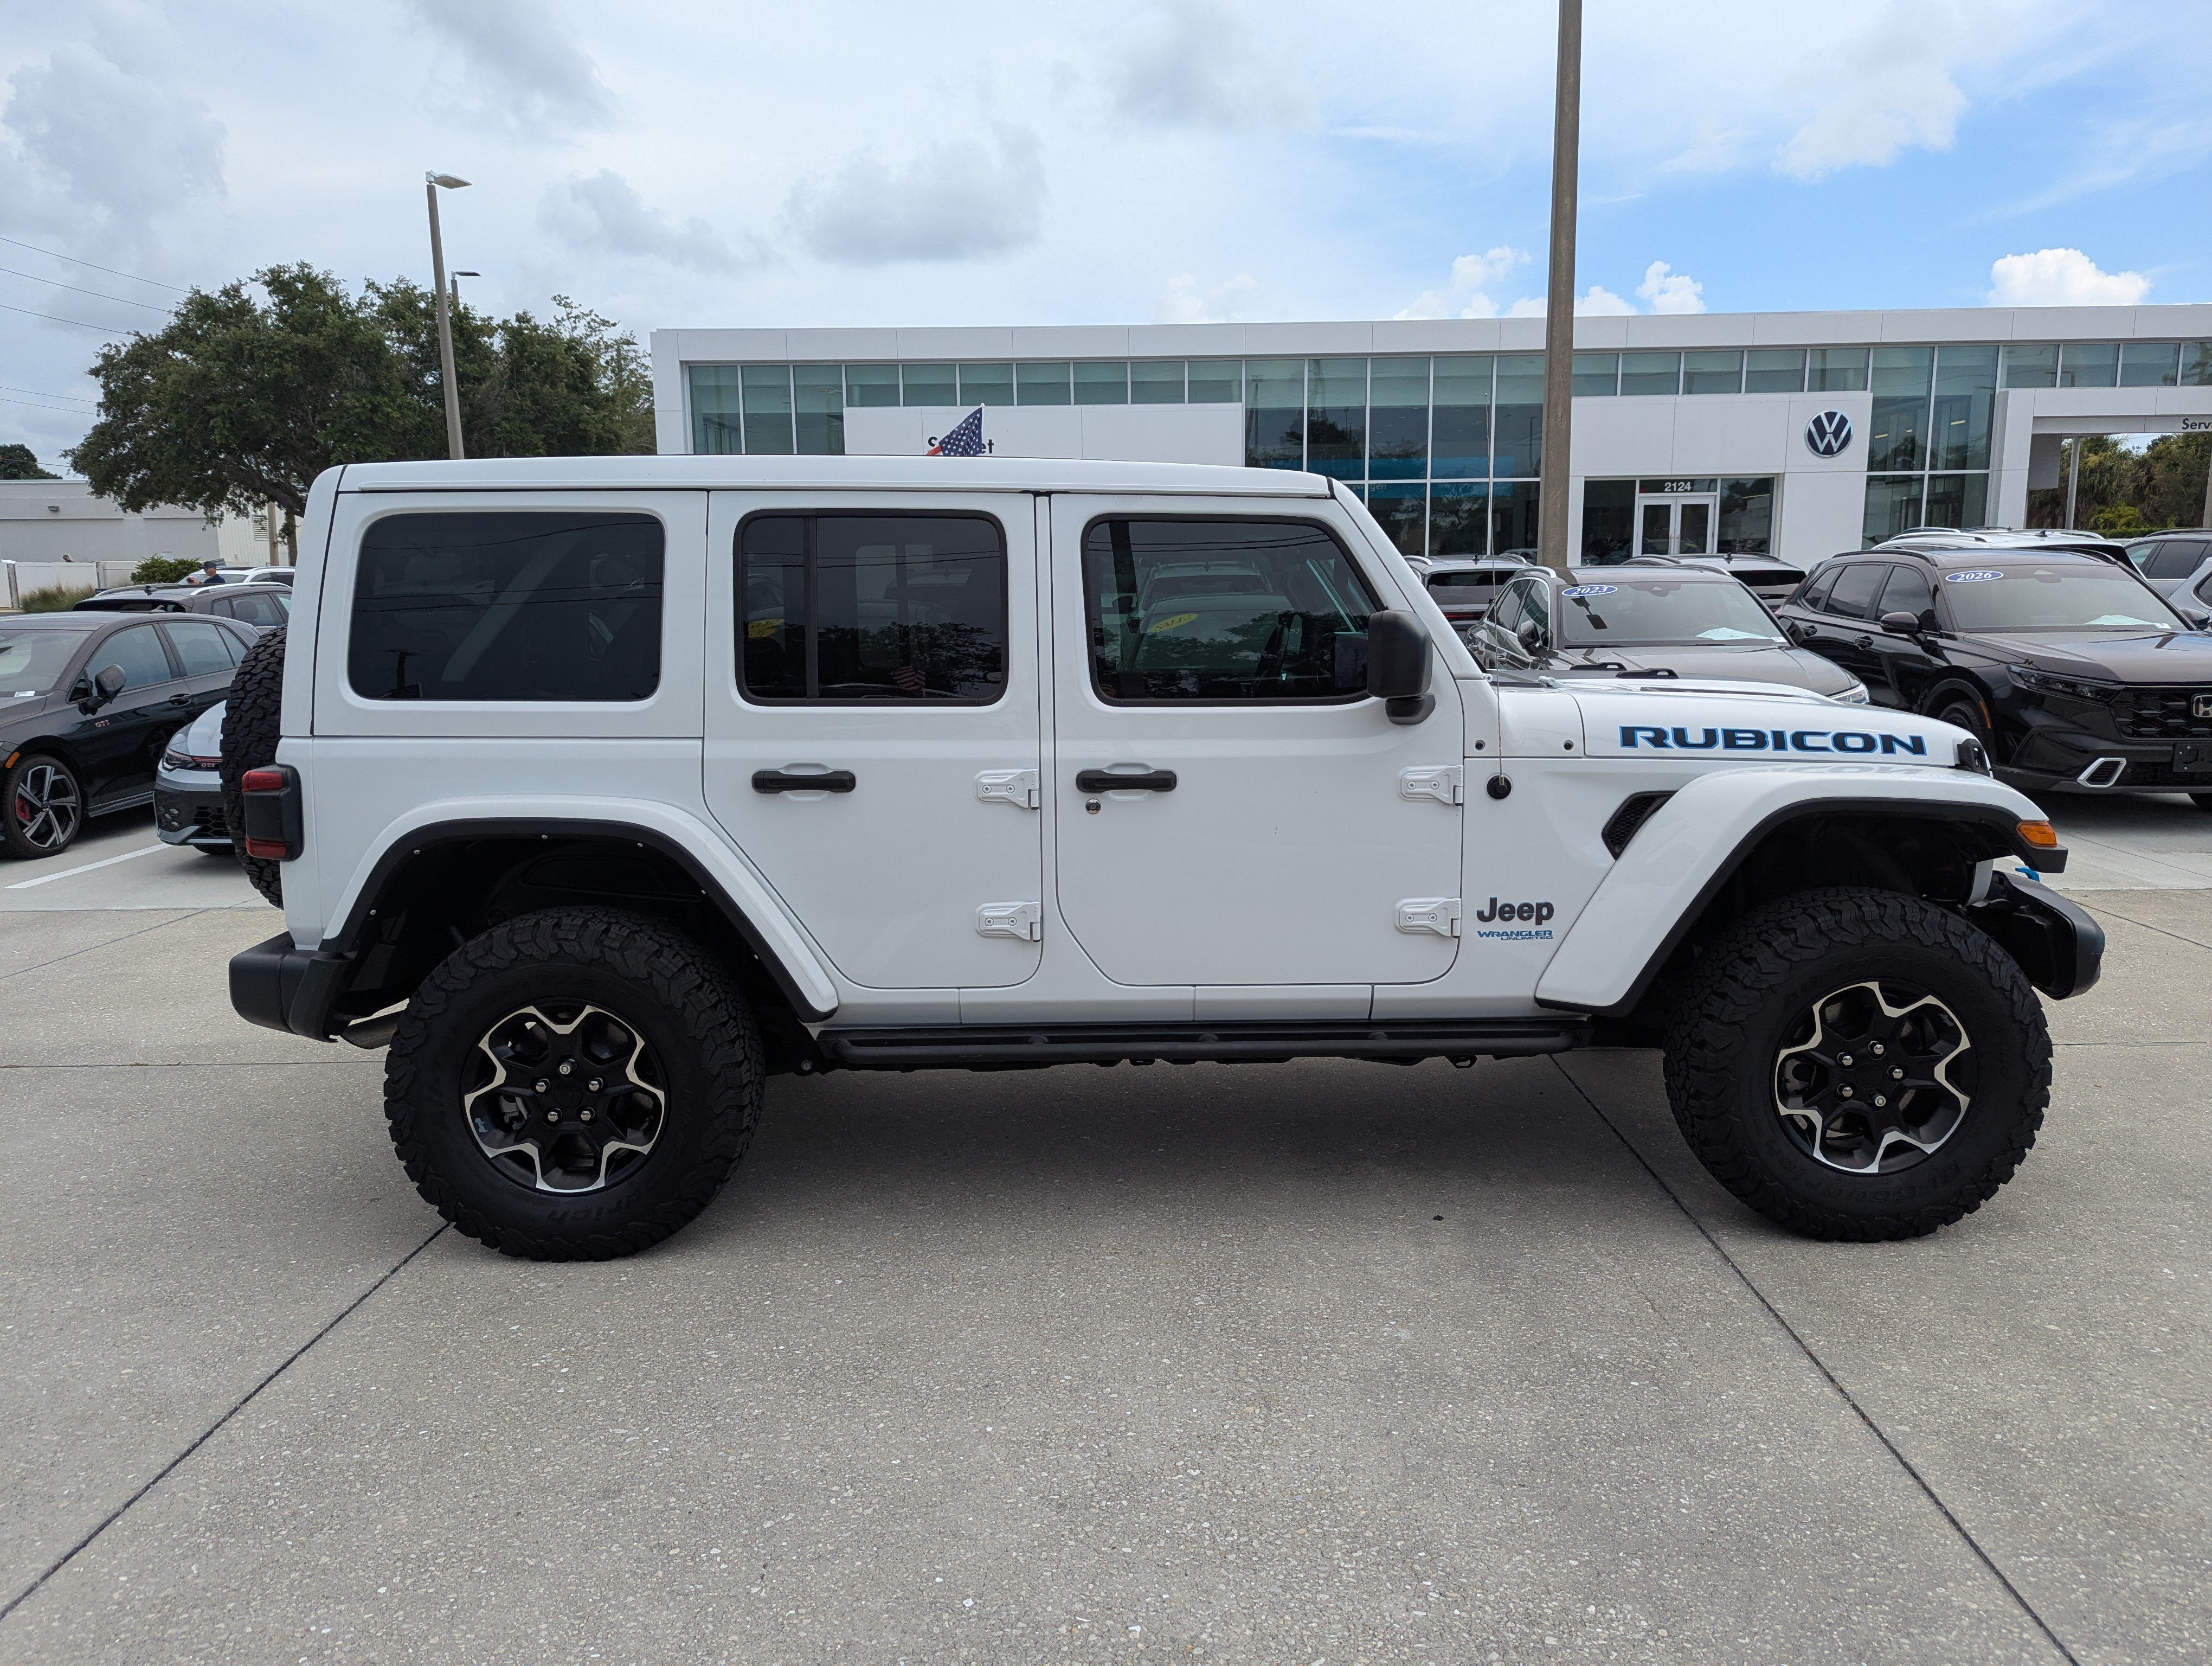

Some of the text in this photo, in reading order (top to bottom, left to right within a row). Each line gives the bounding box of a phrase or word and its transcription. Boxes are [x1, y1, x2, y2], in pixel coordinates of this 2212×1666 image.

[2181, 418, 2212, 430] Serv
[1664, 481, 1692, 491] 2124
[1956, 572, 1992, 581] 2026
[1571, 586, 1609, 595] 2023
[95, 719, 110, 728] GTI
[1619, 725, 1927, 756] RUBICON
[1476, 896, 1554, 926] Jeep
[1477, 930, 1553, 938] WRANGLER
